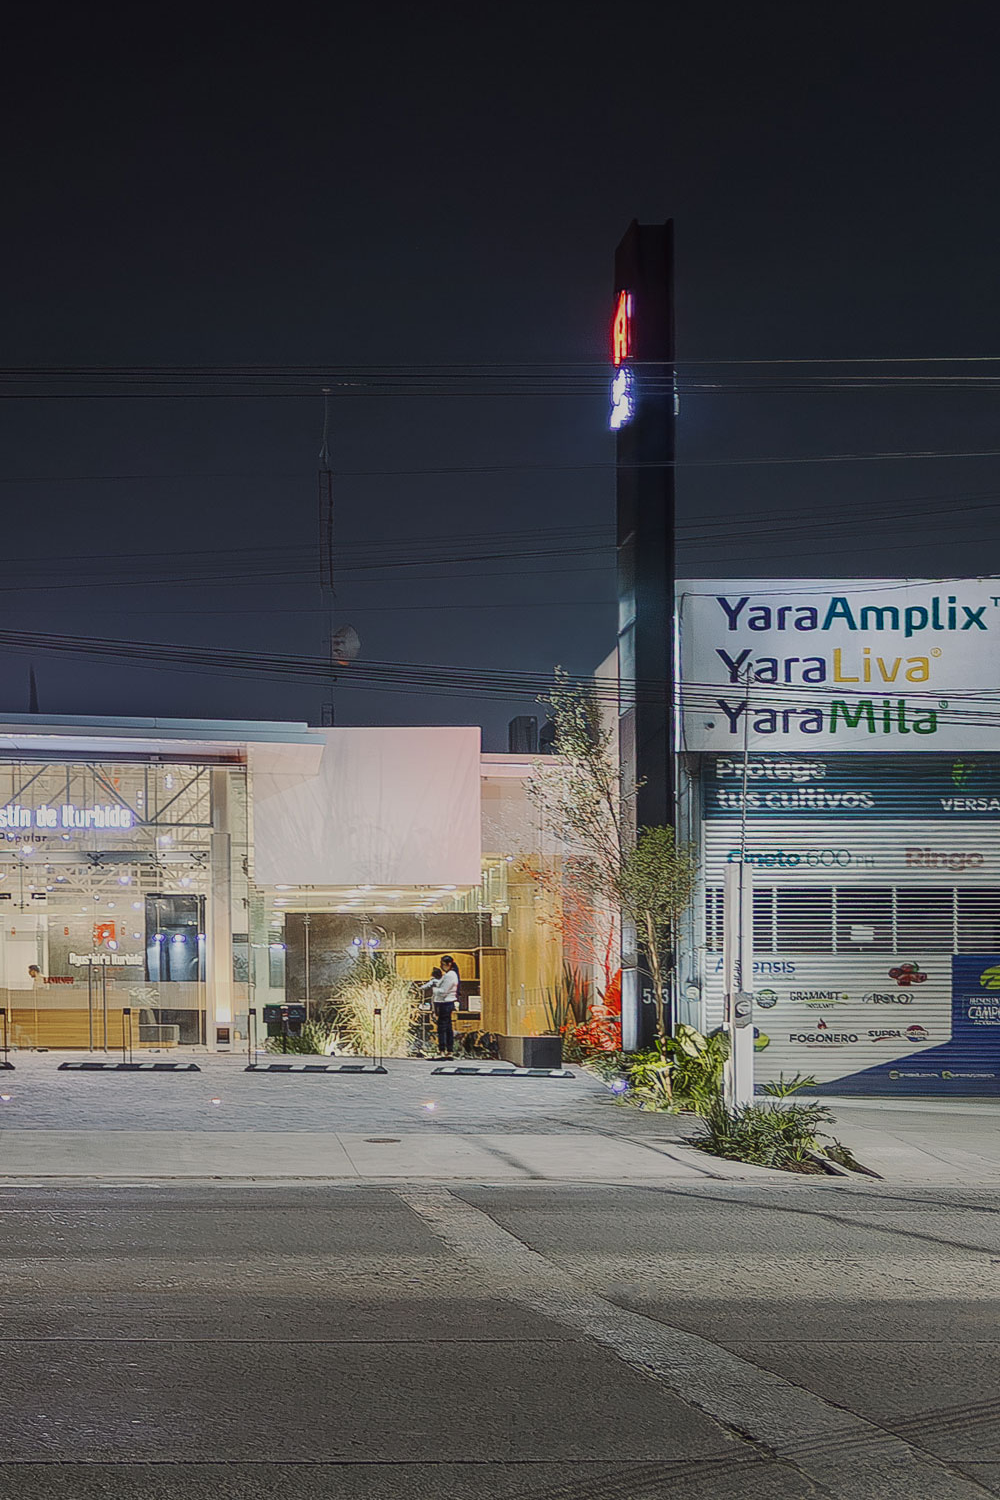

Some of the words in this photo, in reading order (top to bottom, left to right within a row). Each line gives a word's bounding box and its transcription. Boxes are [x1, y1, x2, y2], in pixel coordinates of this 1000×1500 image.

[36, 805, 57, 828] de
[61, 804, 132, 829] Iturbide
[968, 1006, 1000, 1020] CAMP
[789, 1033, 858, 1043] FOGONERO
